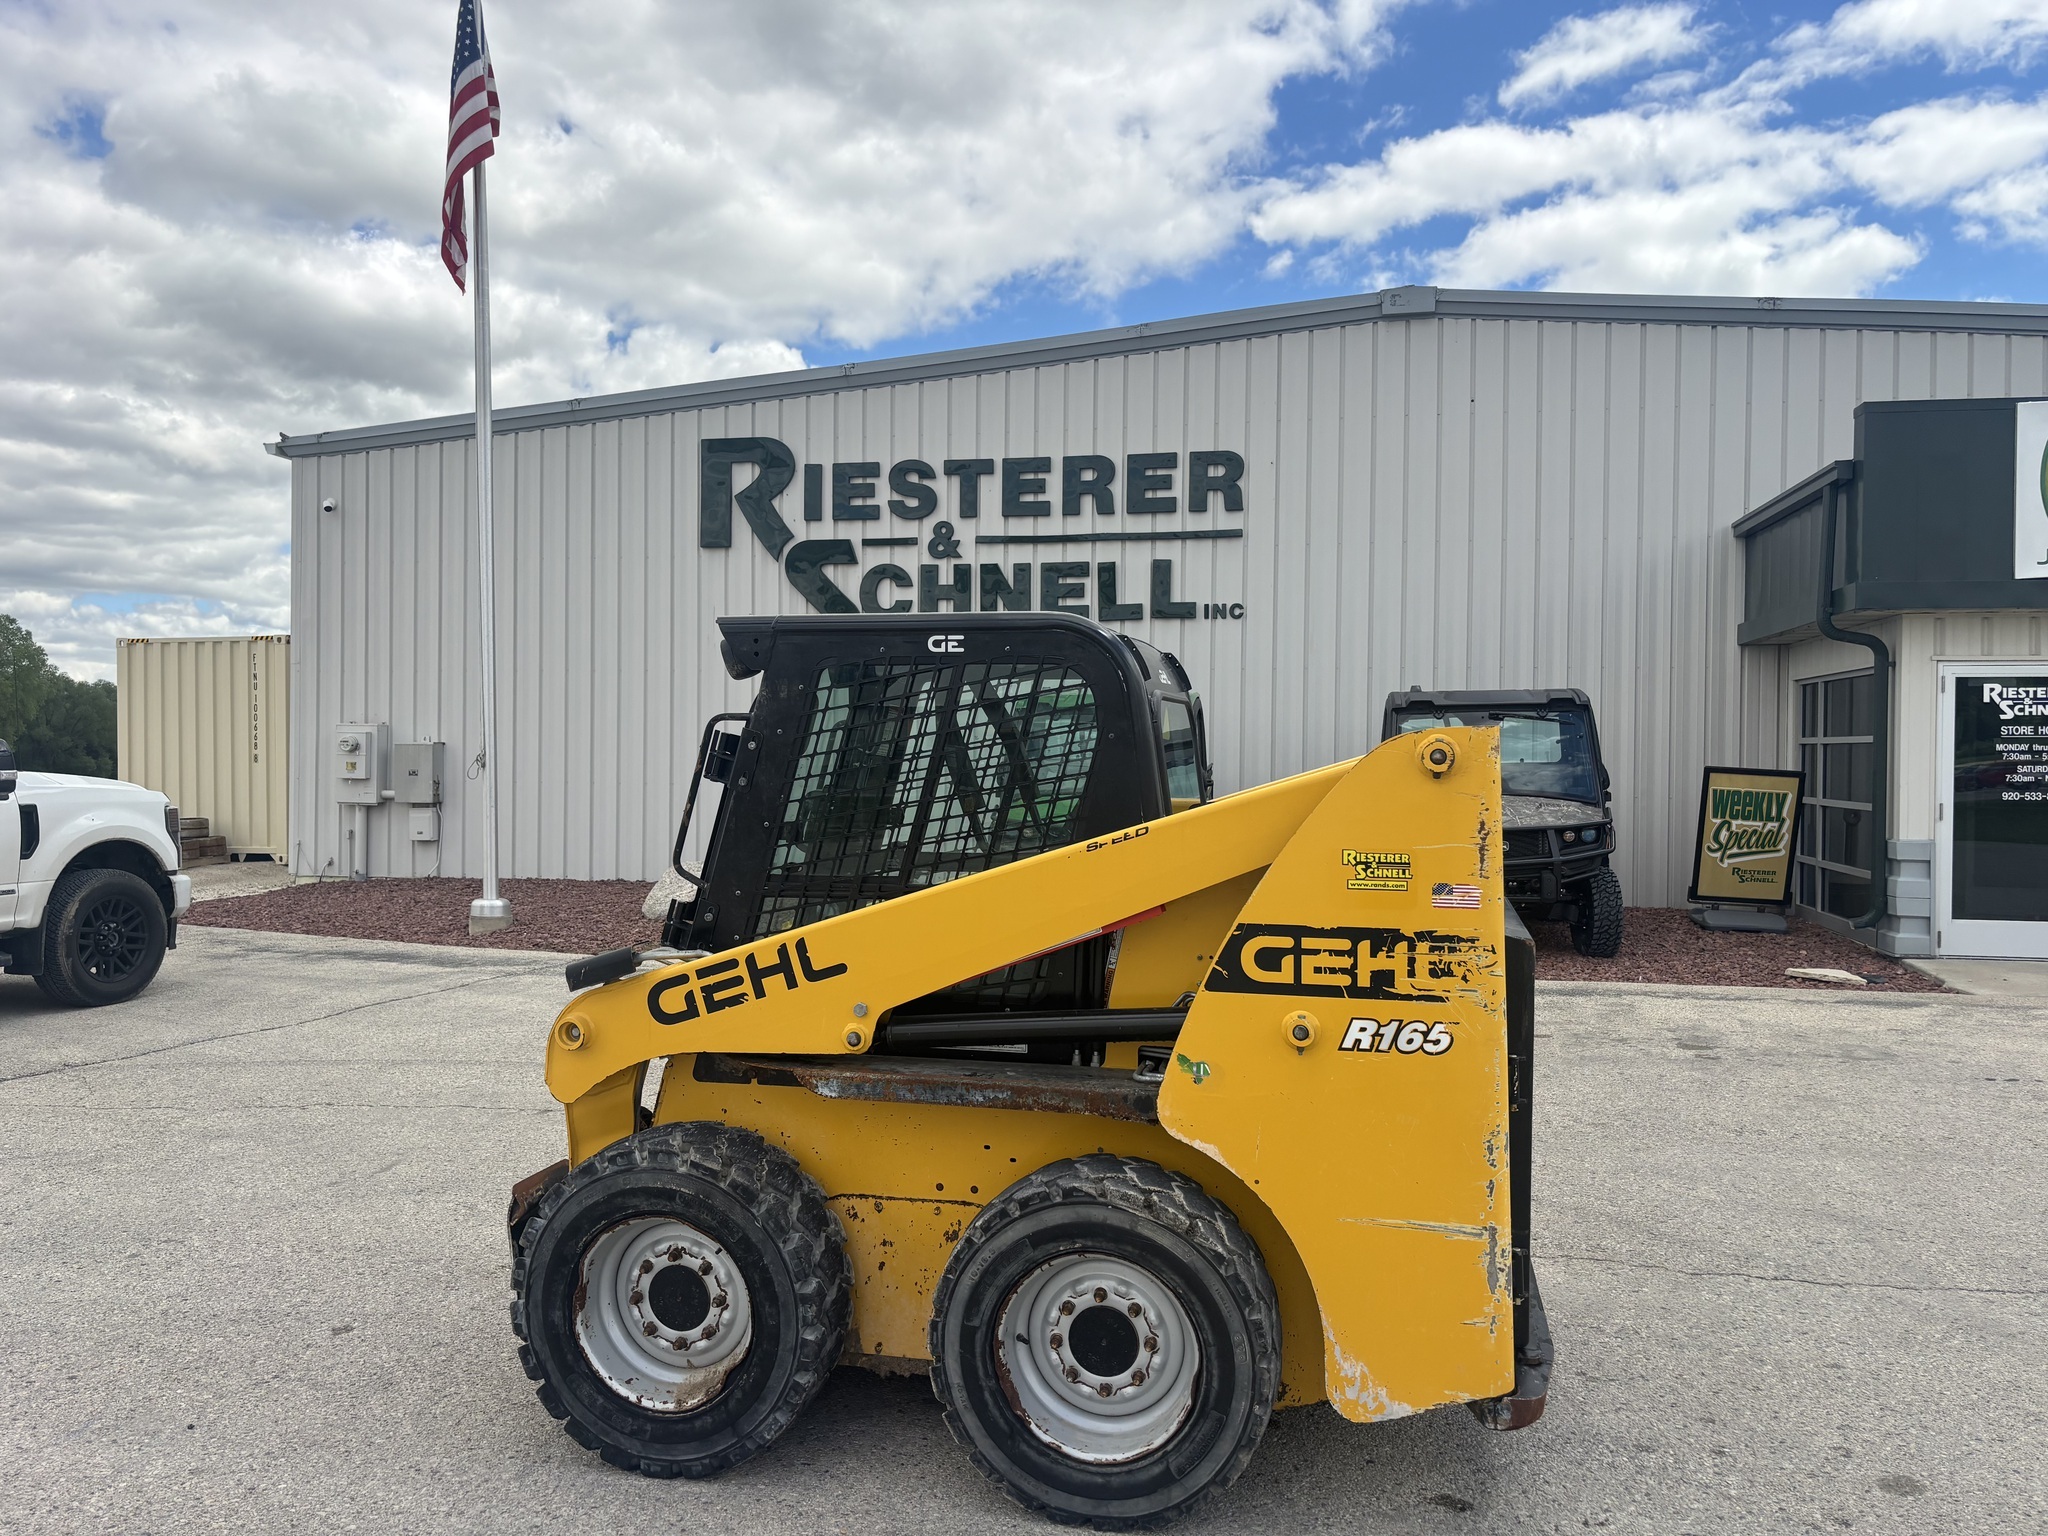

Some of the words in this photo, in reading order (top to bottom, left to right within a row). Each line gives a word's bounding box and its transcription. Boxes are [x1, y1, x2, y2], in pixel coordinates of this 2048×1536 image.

[700, 437, 1245, 561] RIESTERER
[927, 521, 962, 559] &
[784, 539, 1197, 620] SCHNELL
[1204, 602, 1244, 619] INC
[1983, 683, 2048, 705] RIESTE
[2023, 697, 2033, 705] &
[2000, 726, 2034, 735] STORE
[2038, 726, 2048, 735] H
[1706, 818, 1786, 863] Special
[1342, 850, 1410, 866] RIESTERER
[1356, 865, 1412, 879] SCHNELL
[1732, 867, 1777, 876] RIESTERER
[1738, 875, 1776, 883] SCHNELL
[647, 937, 848, 1024] GEHL
[1340, 1019, 1453, 1054] R165
